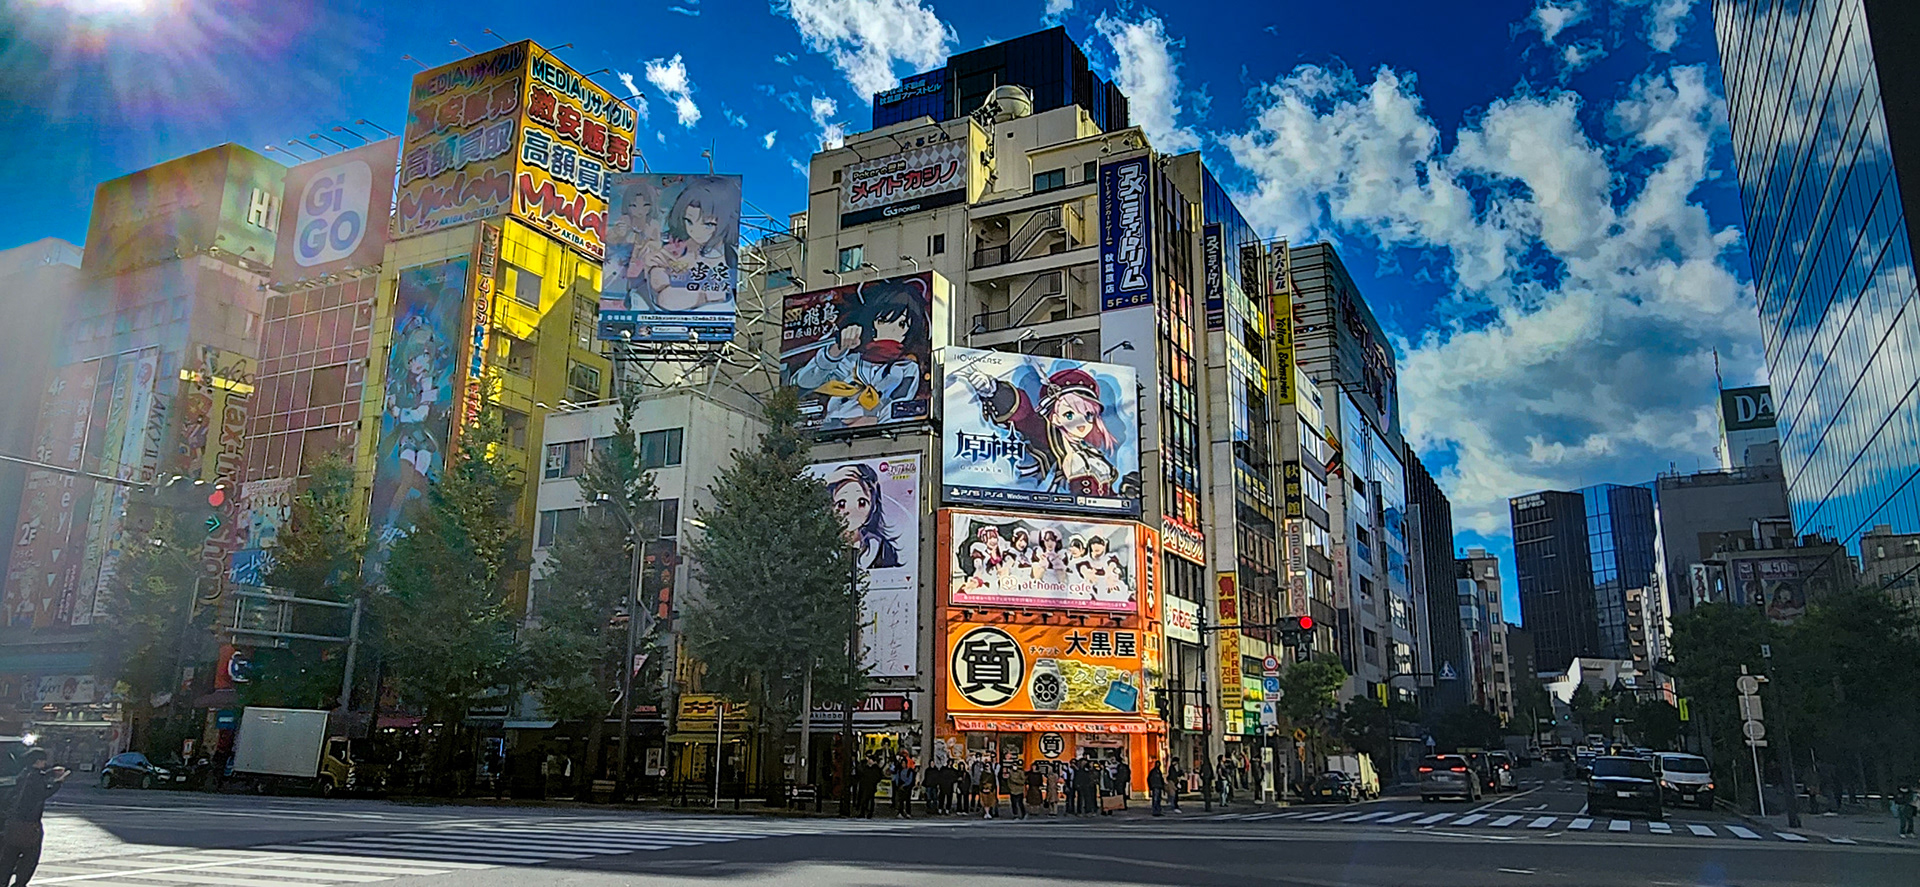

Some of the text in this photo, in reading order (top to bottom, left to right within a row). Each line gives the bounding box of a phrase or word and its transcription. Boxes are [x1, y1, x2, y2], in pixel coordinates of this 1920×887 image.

[531, 55, 634, 133] MEDIAリサイクル
[528, 84, 632, 171] 激安販売
[305, 173, 345, 216] Gi
[850, 160, 959, 204] メイドカジノ
[516, 172, 608, 246] Mula
[300, 210, 361, 259] GO
[527, 211, 561, 236] ムーラン
[561, 230, 584, 248] AKIBA
[953, 421, 1024, 474] 原神
[1007, 493, 1030, 501] Windows
[18, 522, 37, 546] 2F
[1069, 582, 1091, 592] cafe
[1029, 646, 1059, 655] チケット
[1064, 630, 1136, 657] 大黒屋
[960, 638, 1017, 696] 質
[1231, 652, 1239, 684] FREE
[863, 697, 884, 711] ZIN
[1042, 736, 1061, 755] 質
